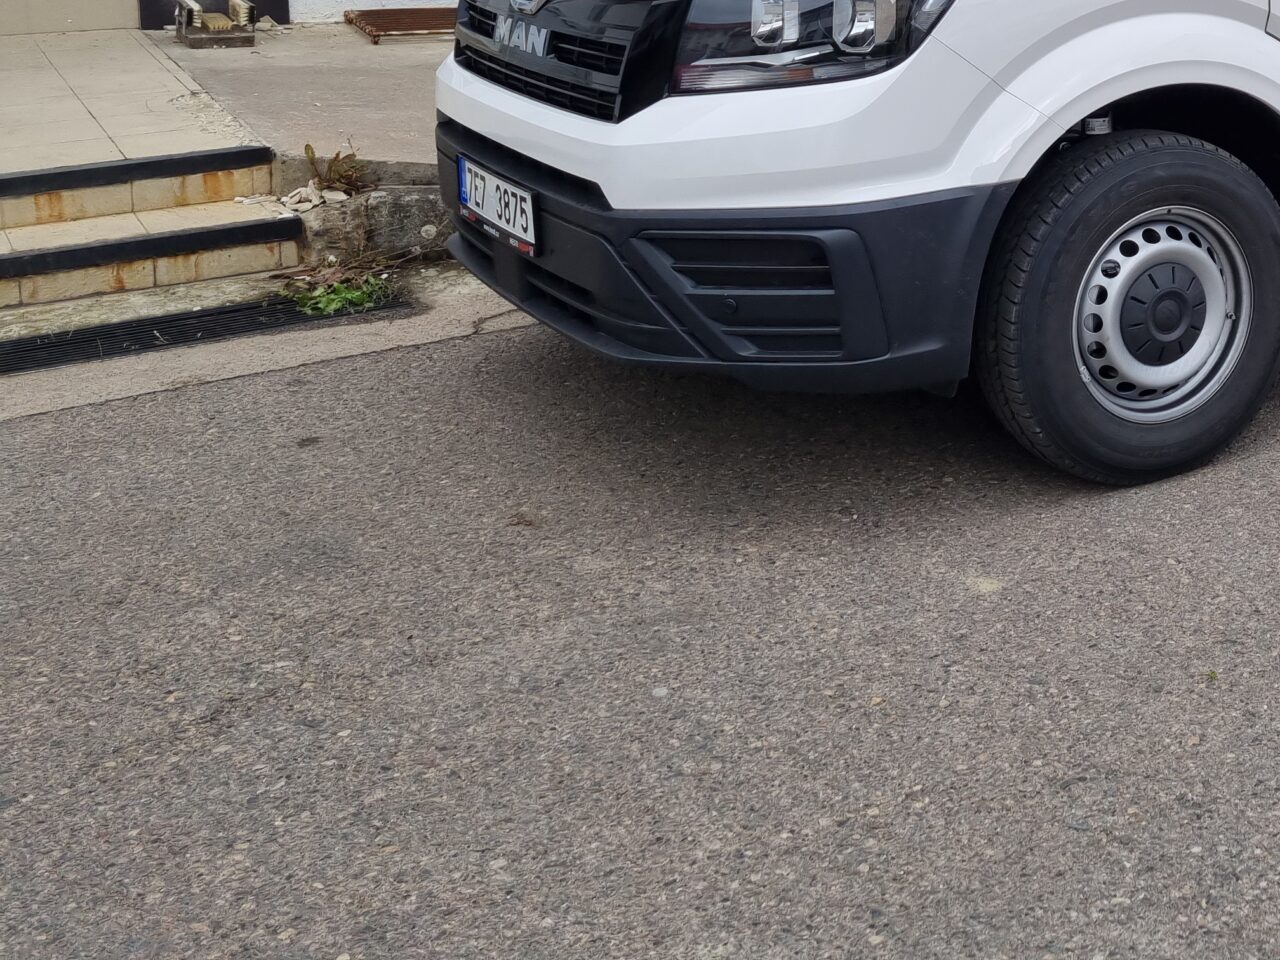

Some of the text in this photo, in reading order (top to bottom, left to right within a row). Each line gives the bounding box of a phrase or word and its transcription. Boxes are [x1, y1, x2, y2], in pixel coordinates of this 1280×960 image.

[494, 15, 548, 57] MAN
[467, 167, 486, 210] 7E7
[496, 183, 529, 234] 3875
